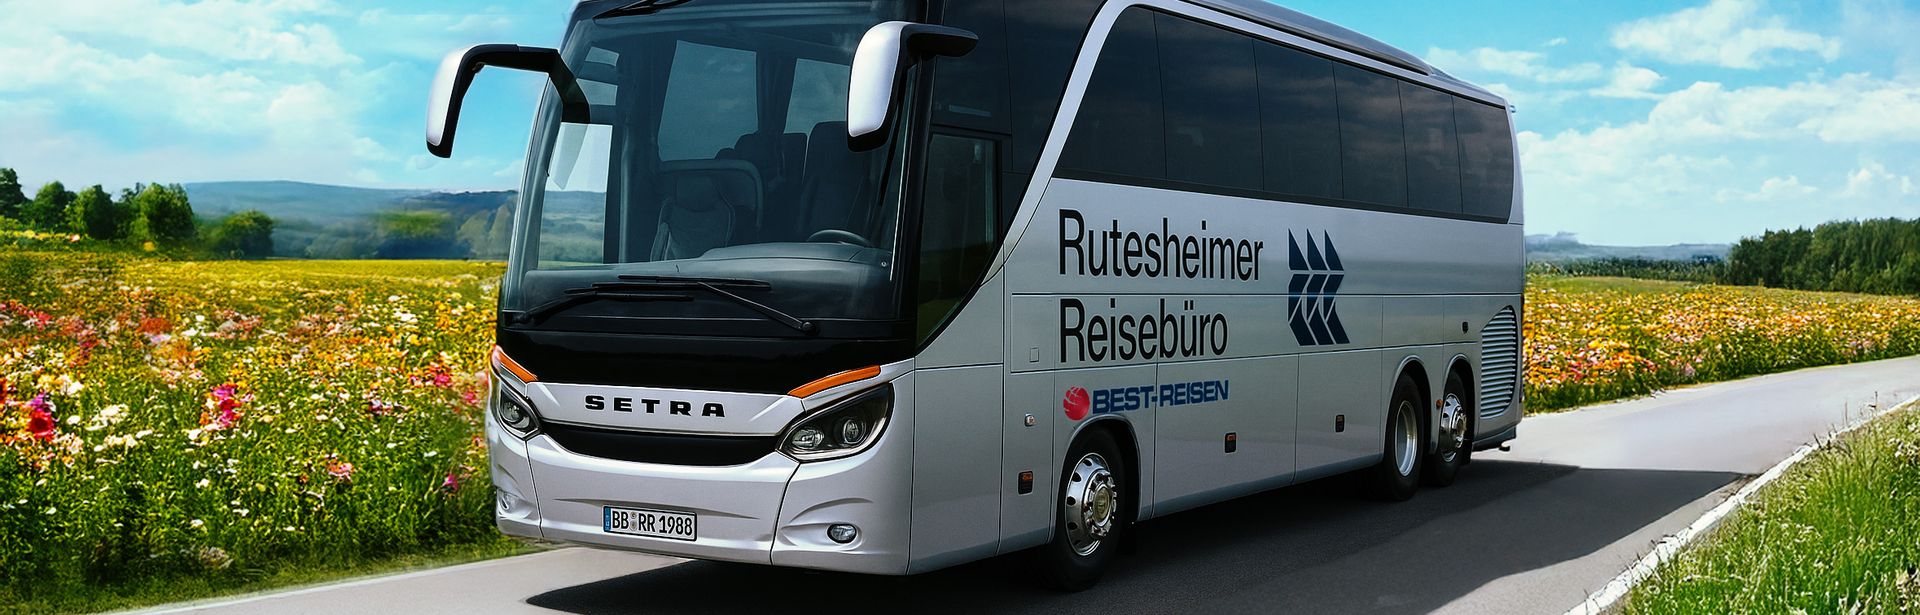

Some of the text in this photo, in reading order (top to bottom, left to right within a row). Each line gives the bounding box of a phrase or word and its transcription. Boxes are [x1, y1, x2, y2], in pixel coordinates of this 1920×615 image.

[1059, 209, 1263, 281] Rutesheimer
[1060, 298, 1228, 363] Reisebüro
[585, 395, 725, 417] SETRA
[1092, 380, 1229, 414] BEST-REISEN
[612, 511, 693, 535] BB RR 1988
